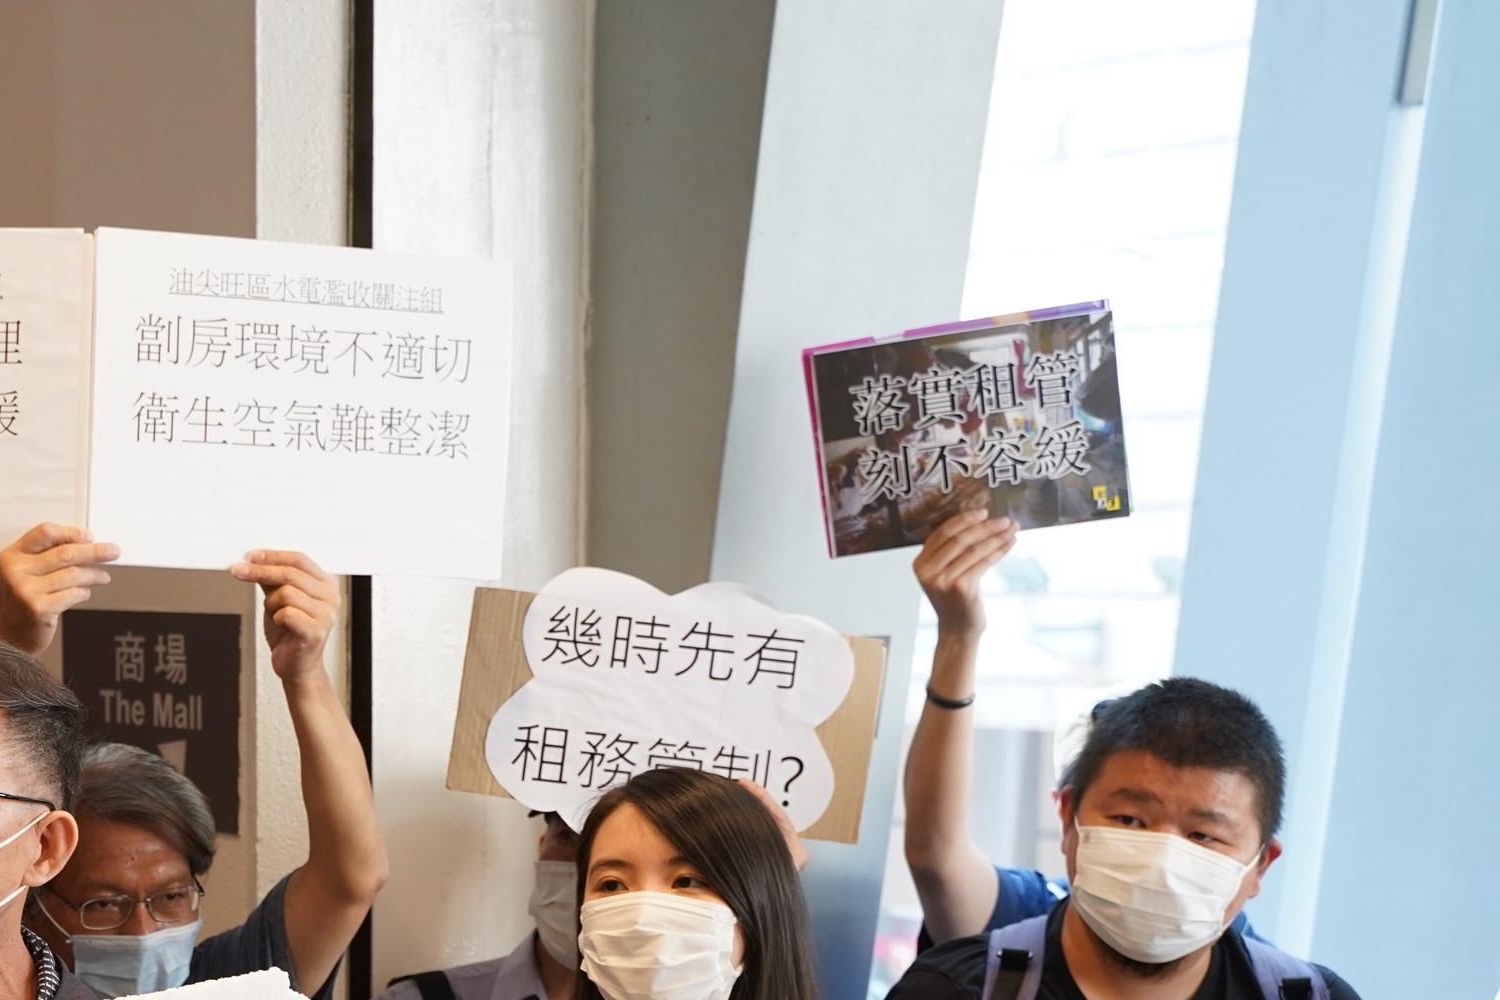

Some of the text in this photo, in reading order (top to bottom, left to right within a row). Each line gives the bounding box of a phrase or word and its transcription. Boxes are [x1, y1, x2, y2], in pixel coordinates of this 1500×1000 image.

[169, 267, 444, 315] 油尖旺區水電濫收關注組
[135, 314, 472, 384] 劏房環境不適切
[133, 391, 471, 460] 衛生空氣難整潔
[850, 353, 1080, 435] 落實租管
[859, 420, 1092, 501] 刻不容緩
[114, 631, 187, 685] 商場
[541, 604, 805, 690] 幾時先有
[99, 689, 202, 730] The Mall
